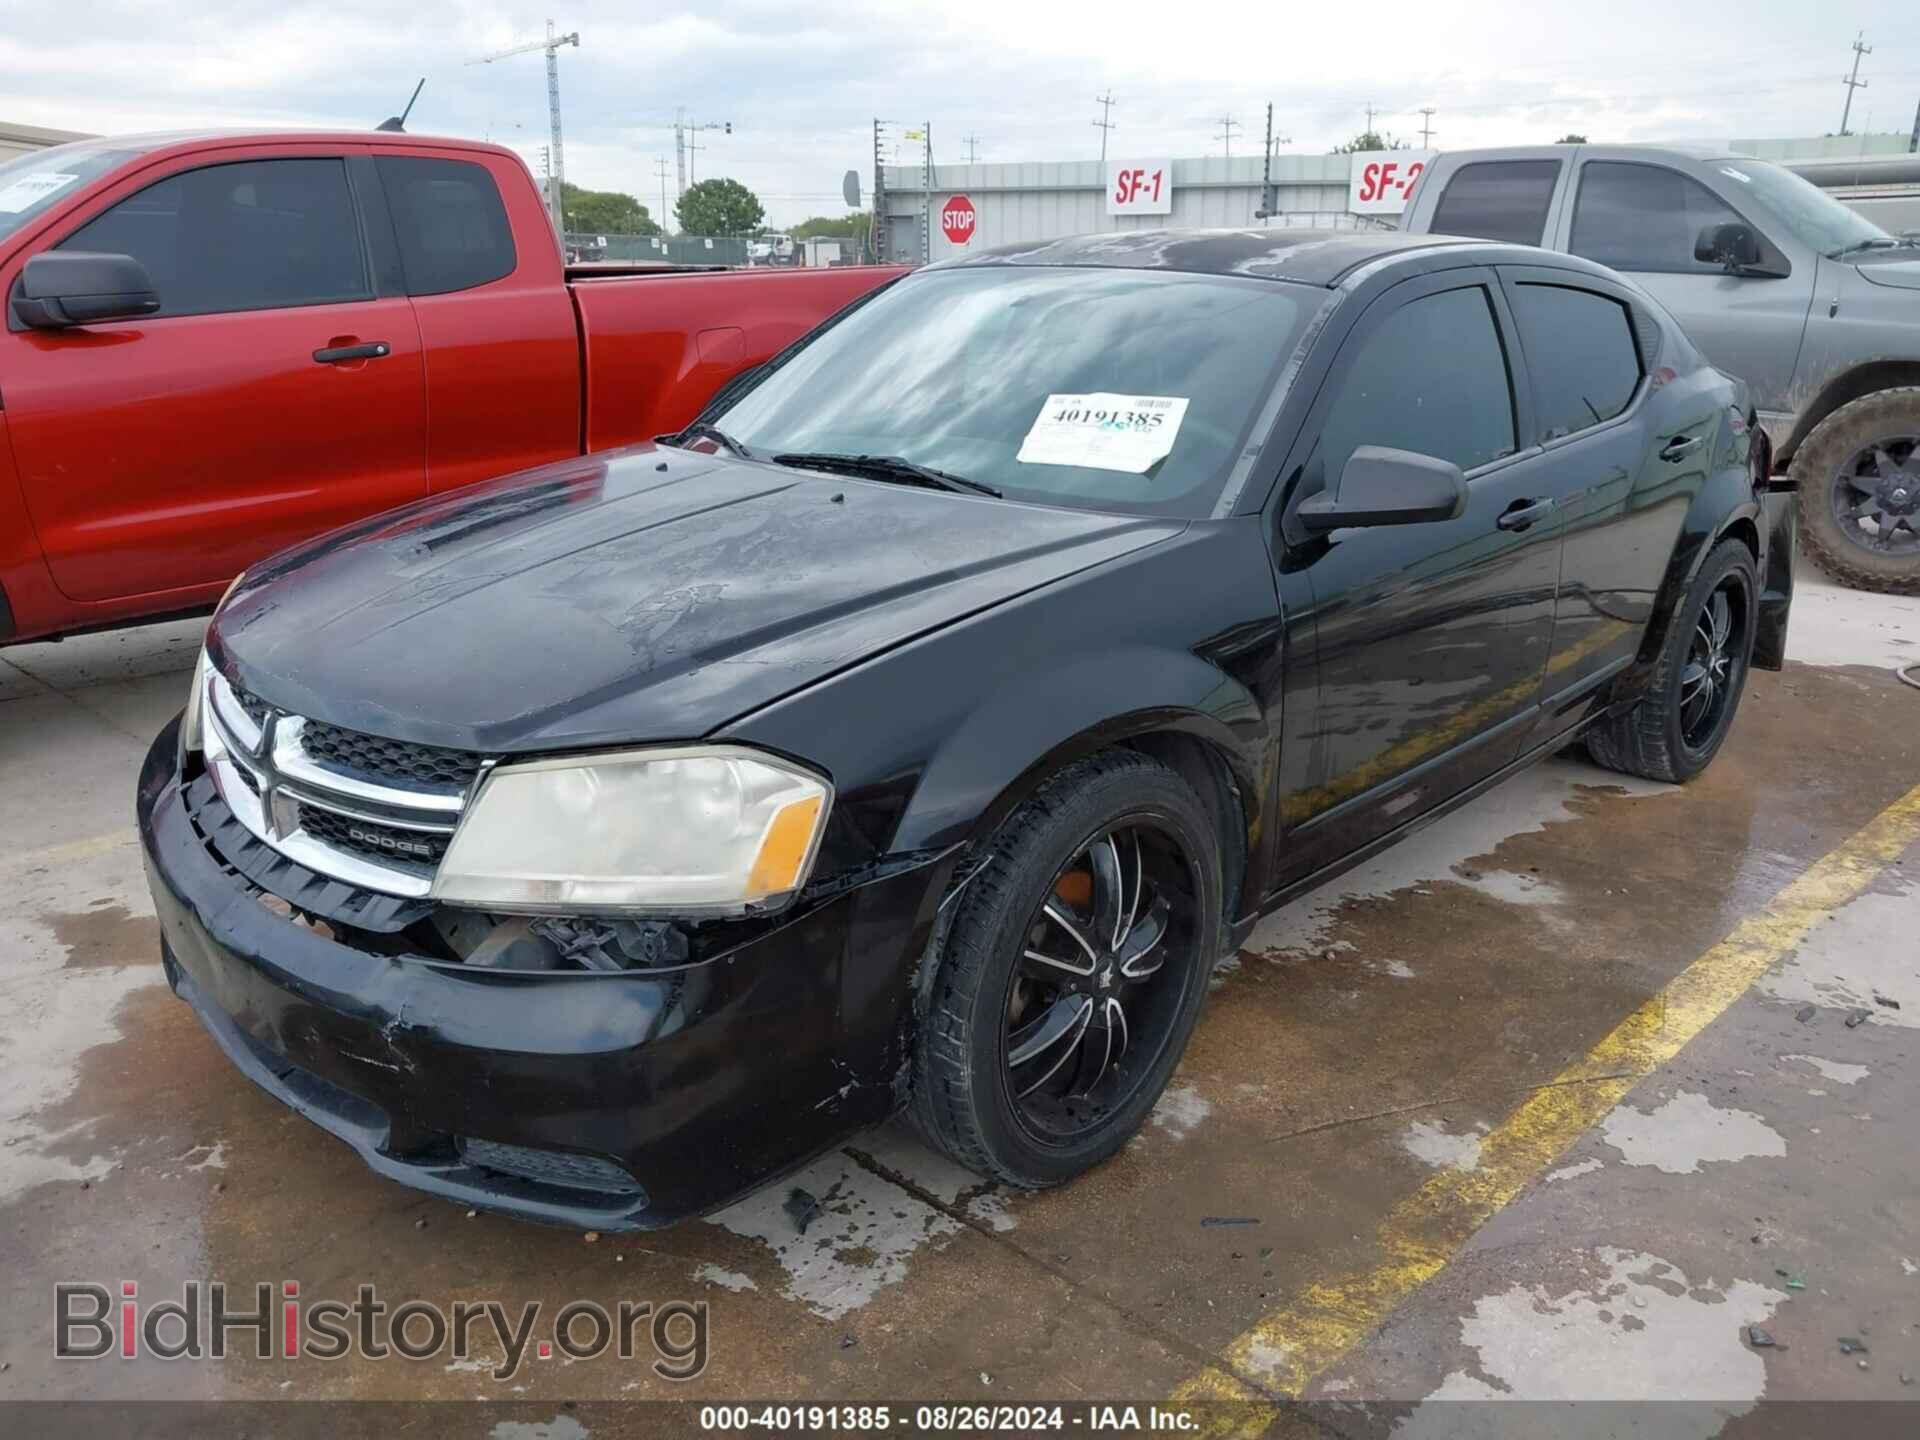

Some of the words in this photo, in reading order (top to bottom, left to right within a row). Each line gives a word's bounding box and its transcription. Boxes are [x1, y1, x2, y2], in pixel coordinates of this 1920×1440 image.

[1115, 169, 1162, 203] SF-1
[943, 210, 974, 229] STOP
[1053, 408, 1165, 428] 40191385
[350, 829, 430, 855] DODGE
